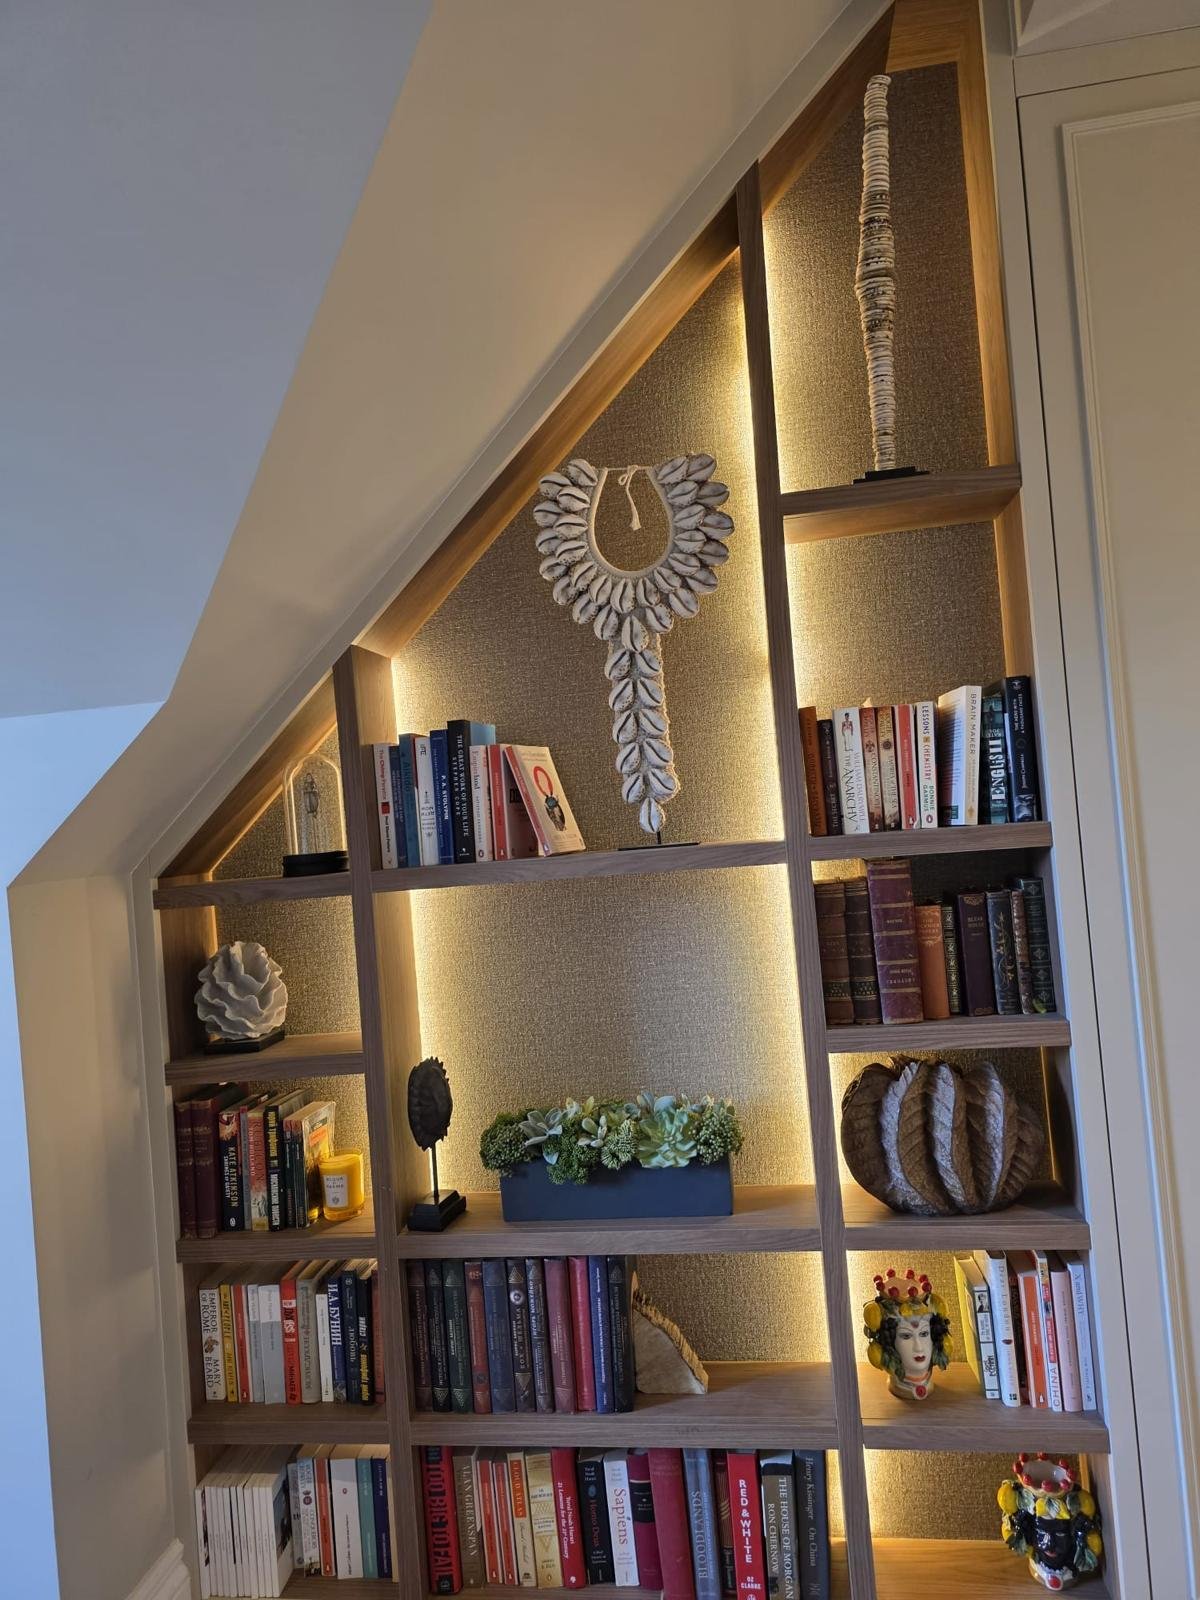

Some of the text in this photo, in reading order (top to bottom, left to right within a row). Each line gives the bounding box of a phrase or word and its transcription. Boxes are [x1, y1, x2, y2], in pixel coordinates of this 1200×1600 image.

[378, 760, 386, 778] Chimp
[922, 705, 931, 780] LESSONS CHEMISTRY
[988, 739, 1006, 800] ENGLISH
[460, 792, 466, 801] OF
[471, 751, 481, 790] Empireland
[842, 768, 858, 822] ANARCHY
[853, 752, 866, 821] WILLIAM DALRYMPLE
[871, 753, 880, 809] CONSTANTINOPLE
[228, 1147, 239, 1208] KATE ATKINSON
[253, 1121, 265, 1182] RUBICON
[201, 1293, 211, 1334] OF ROME
[208, 1293, 218, 1333] EMPEROR
[327, 1283, 342, 1346] И.А. БУНИН
[1001, 1294, 1010, 1331] London
[1076, 1296, 1085, 1314] WHY
[205, 1356, 214, 1388] BEARD
[213, 1359, 221, 1386] MARY
[1052, 1367, 1060, 1407] CHINA
[513, 1462, 521, 1489] CLOUD
[427, 1463, 453, 1580] TOO BIG TO FAIL
[462, 1465, 478, 1556] ALAN GREENSPAN
[568, 1526, 576, 1545] Harari
[590, 1499, 601, 1548] Homo Deus
[612, 1488, 630, 1545] Sapiens
[691, 1490, 709, 1579] BLOODLANDS
[738, 1479, 753, 1564] RED & WHITE
[767, 1503, 779, 1573] RON CHERNOW
[804, 1457, 818, 1567] Henry Kissinger On China
[778, 1477, 794, 1600] THE HOUSE OF MORGAN
[740, 1582, 762, 1590] CLARKE
